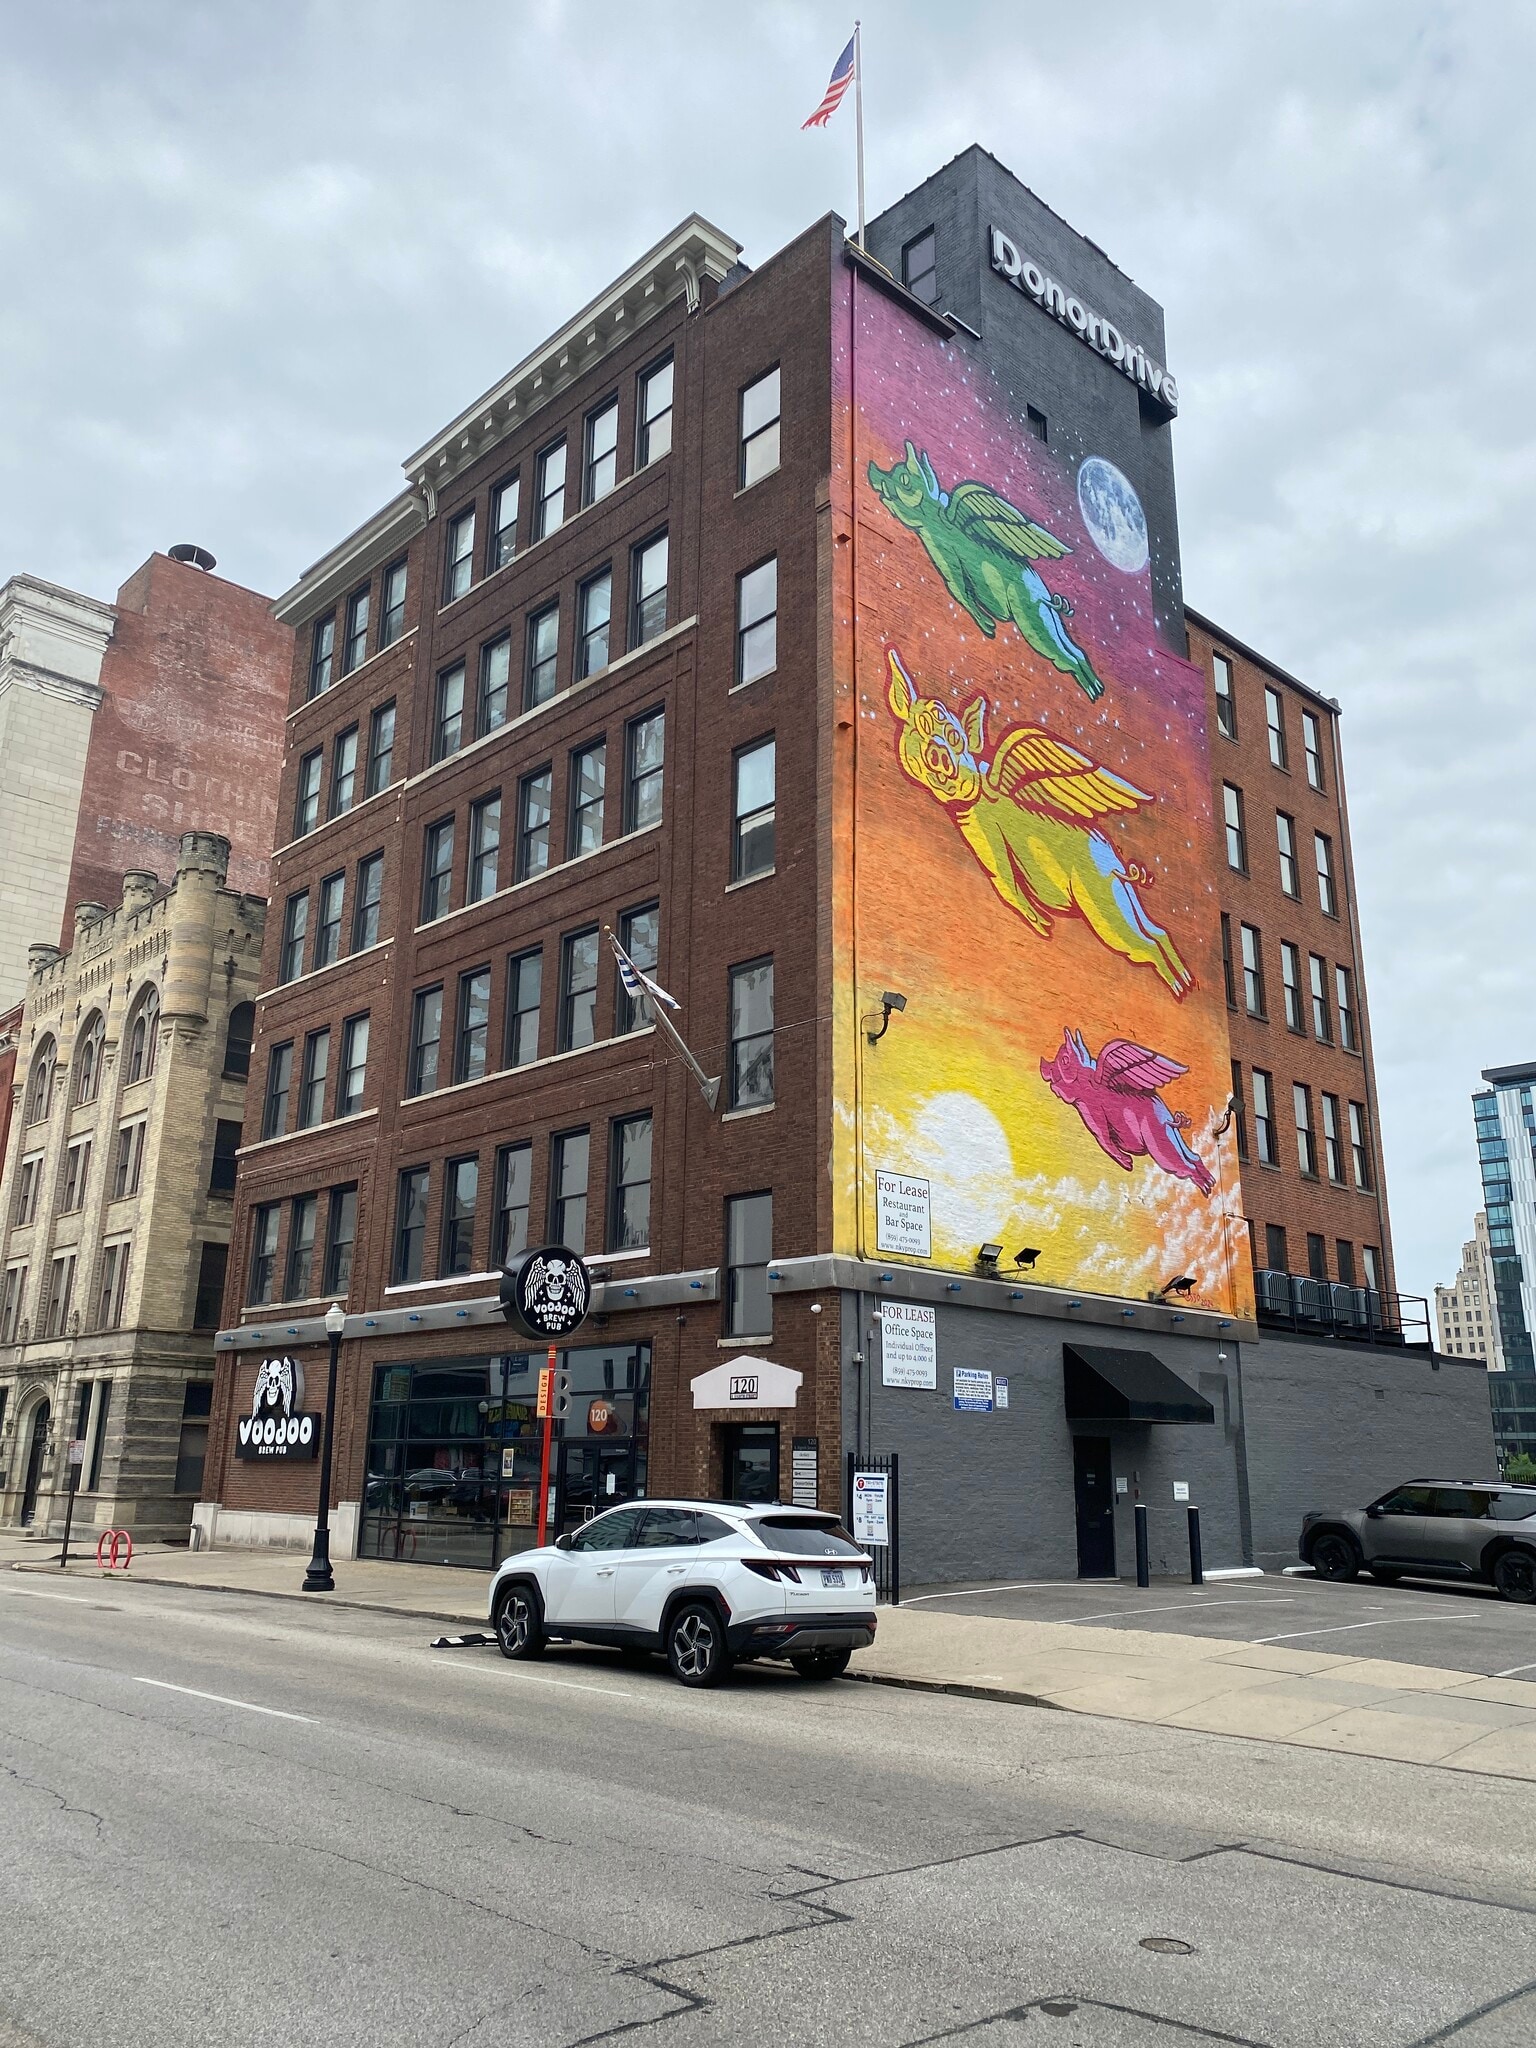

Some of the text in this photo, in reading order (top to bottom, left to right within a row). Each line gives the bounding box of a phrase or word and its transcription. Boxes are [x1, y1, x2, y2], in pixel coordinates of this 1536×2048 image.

[993, 230, 1180, 409] DonorDrive
[878, 1176, 928, 1199] For Lease
[882, 1197, 925, 1214] Restaurant
[885, 1215, 923, 1232] Bar Space
[543, 1313, 566, 1322] BREW
[882, 1305, 935, 1324] FOR LEASE
[546, 1322, 562, 1330] PUB
[885, 1323, 933, 1340] Office Space
[886, 1341, 933, 1353] Individual Offices
[886, 1351, 897, 1360] and
[898, 1354, 905, 1362] up
[540, 1375, 548, 1411] DESIGN
[734, 1378, 755, 1393] 120
[591, 1409, 608, 1421] 120
[258, 1446, 287, 1454] BREW PUB
